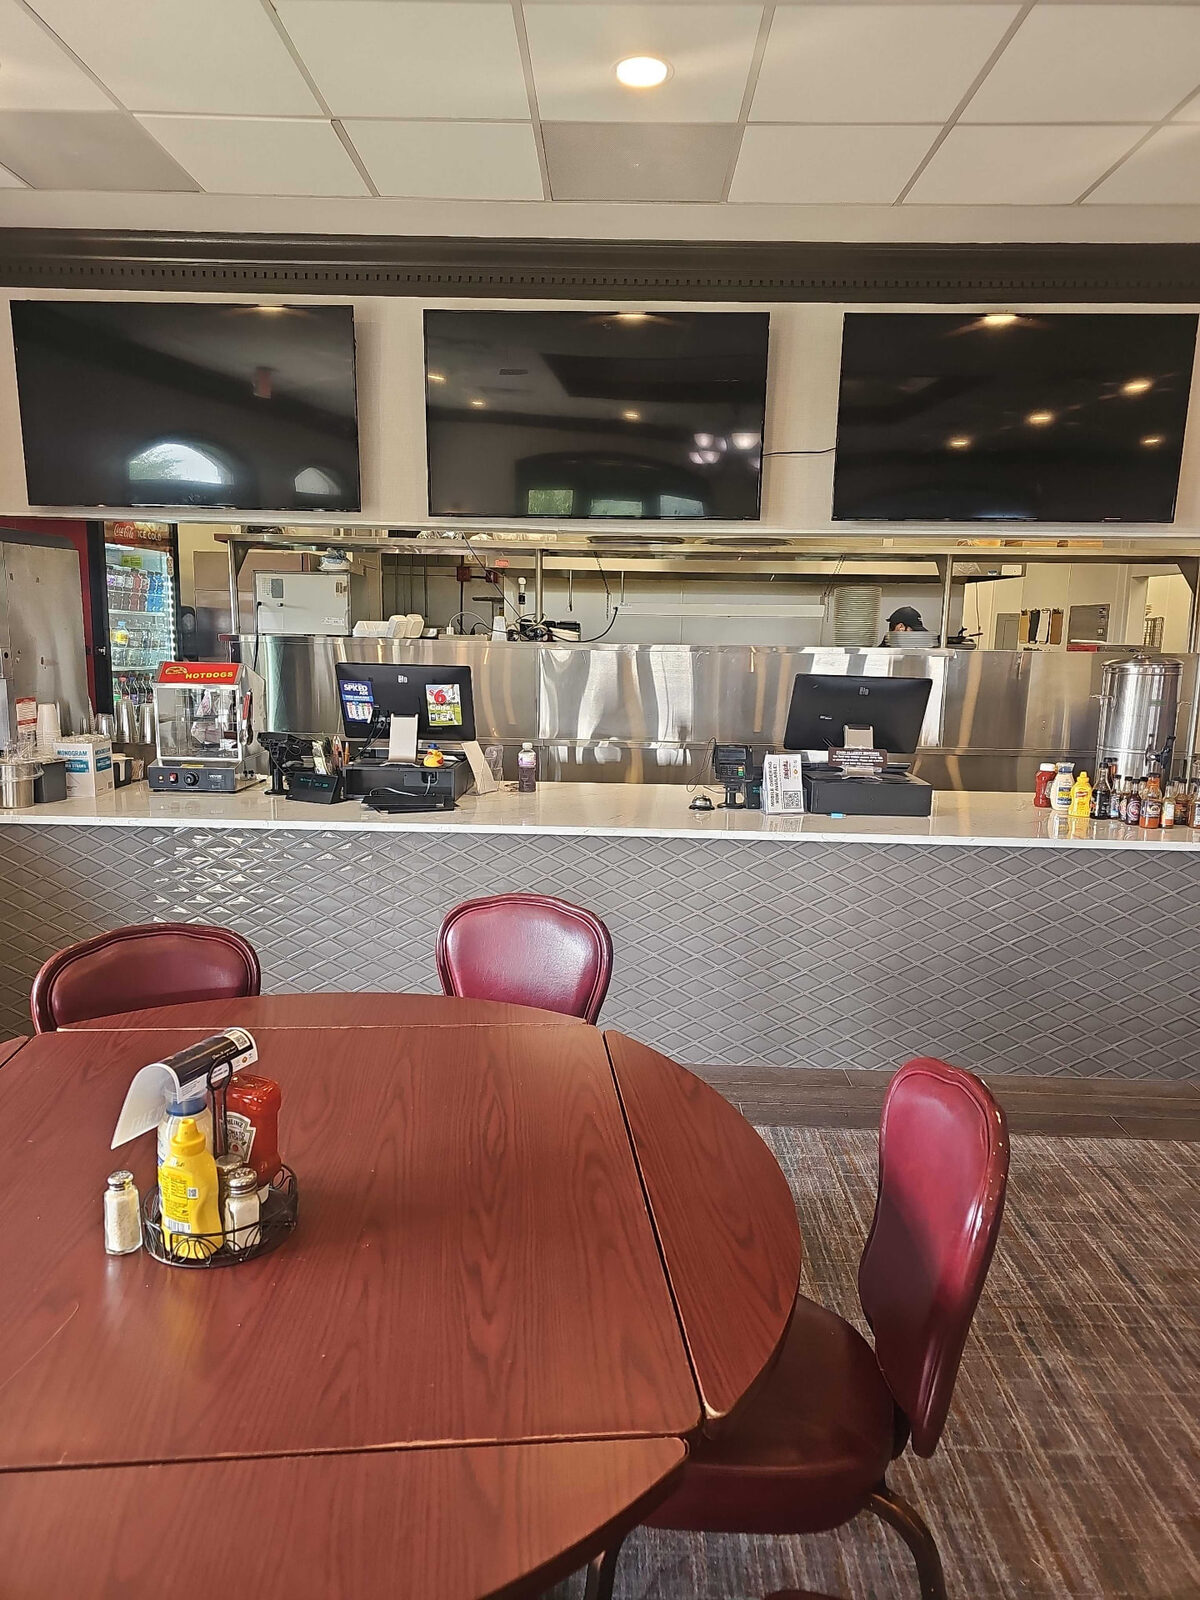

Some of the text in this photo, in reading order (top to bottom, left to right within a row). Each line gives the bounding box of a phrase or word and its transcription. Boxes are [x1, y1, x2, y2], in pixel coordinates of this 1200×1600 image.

[137, 531, 162, 541] ICE COLD
[185, 671, 234, 680] HOTDOGS
[228, 1128, 246, 1138] OMATO
